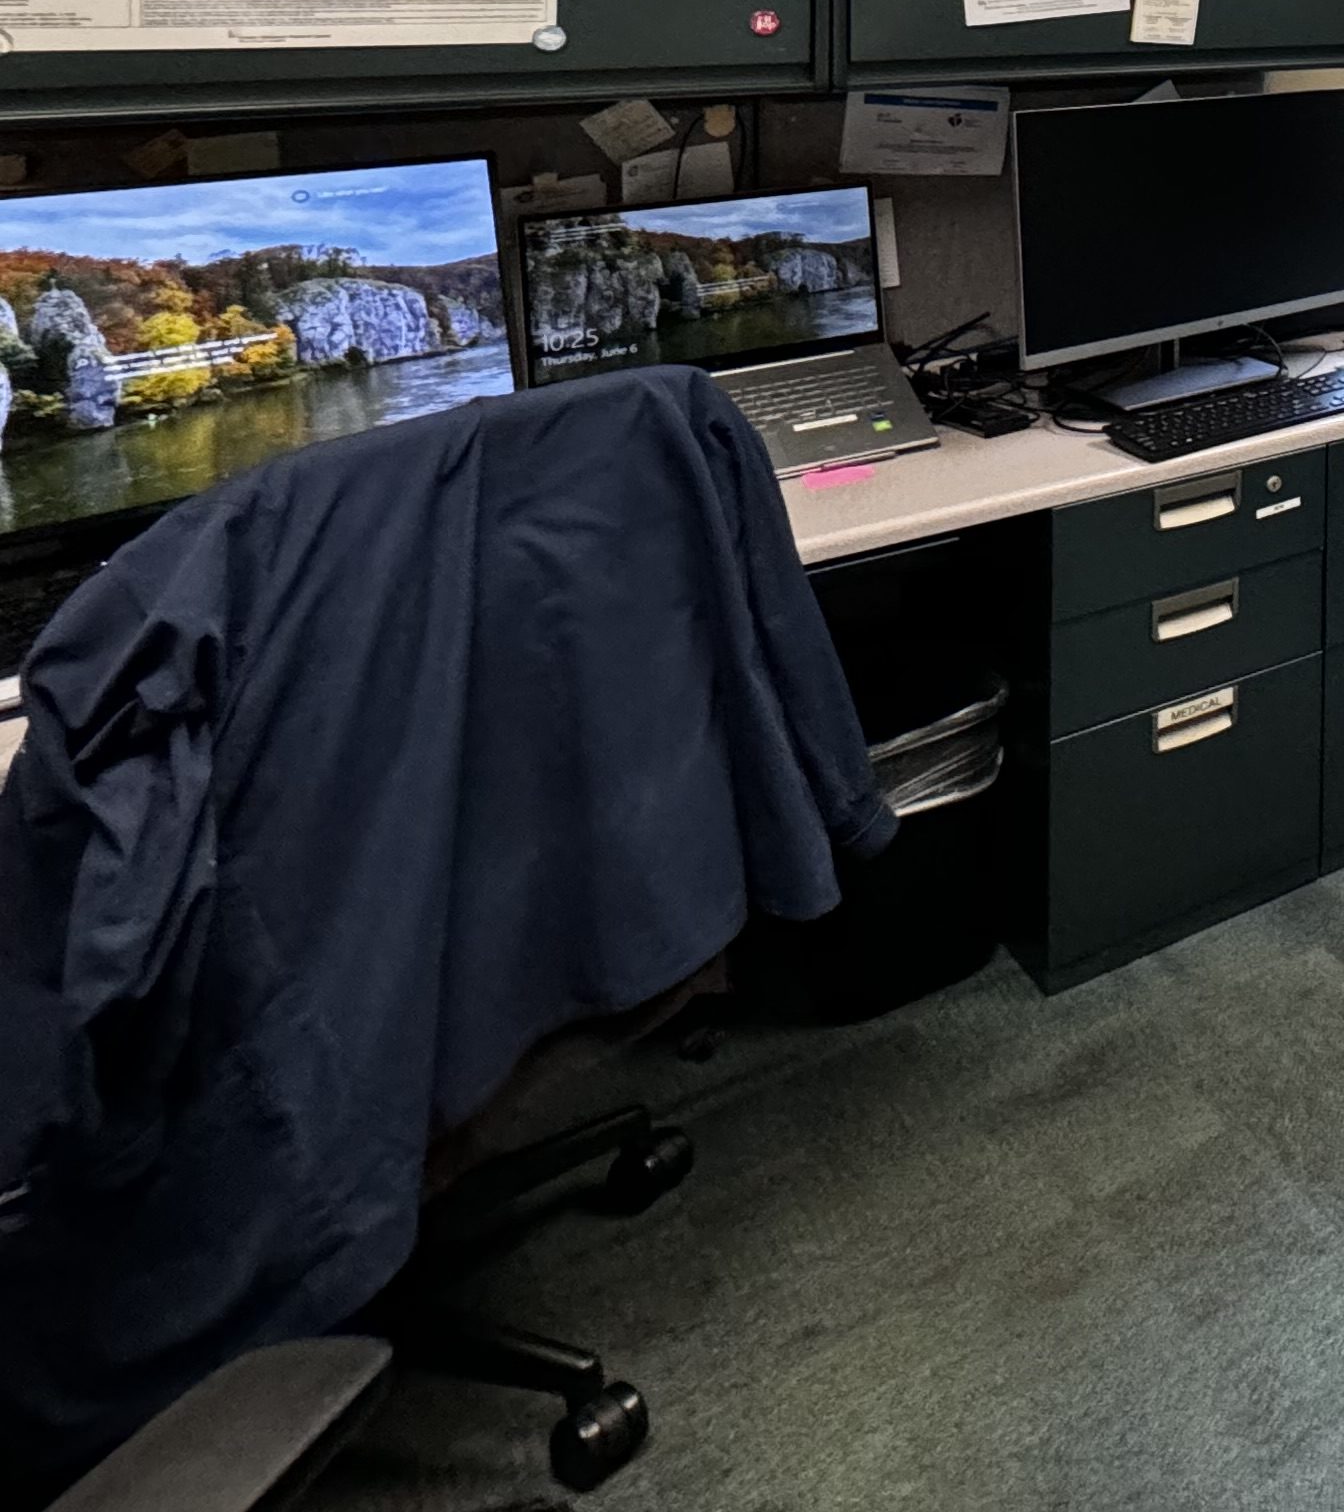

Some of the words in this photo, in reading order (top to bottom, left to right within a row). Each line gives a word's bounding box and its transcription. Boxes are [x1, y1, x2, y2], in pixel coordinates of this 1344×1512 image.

[543, 328, 599, 352] 10:25
[601, 346, 628, 358] June
[629, 343, 638, 354] 6
[1170, 696, 1221, 721] MEDICAL
